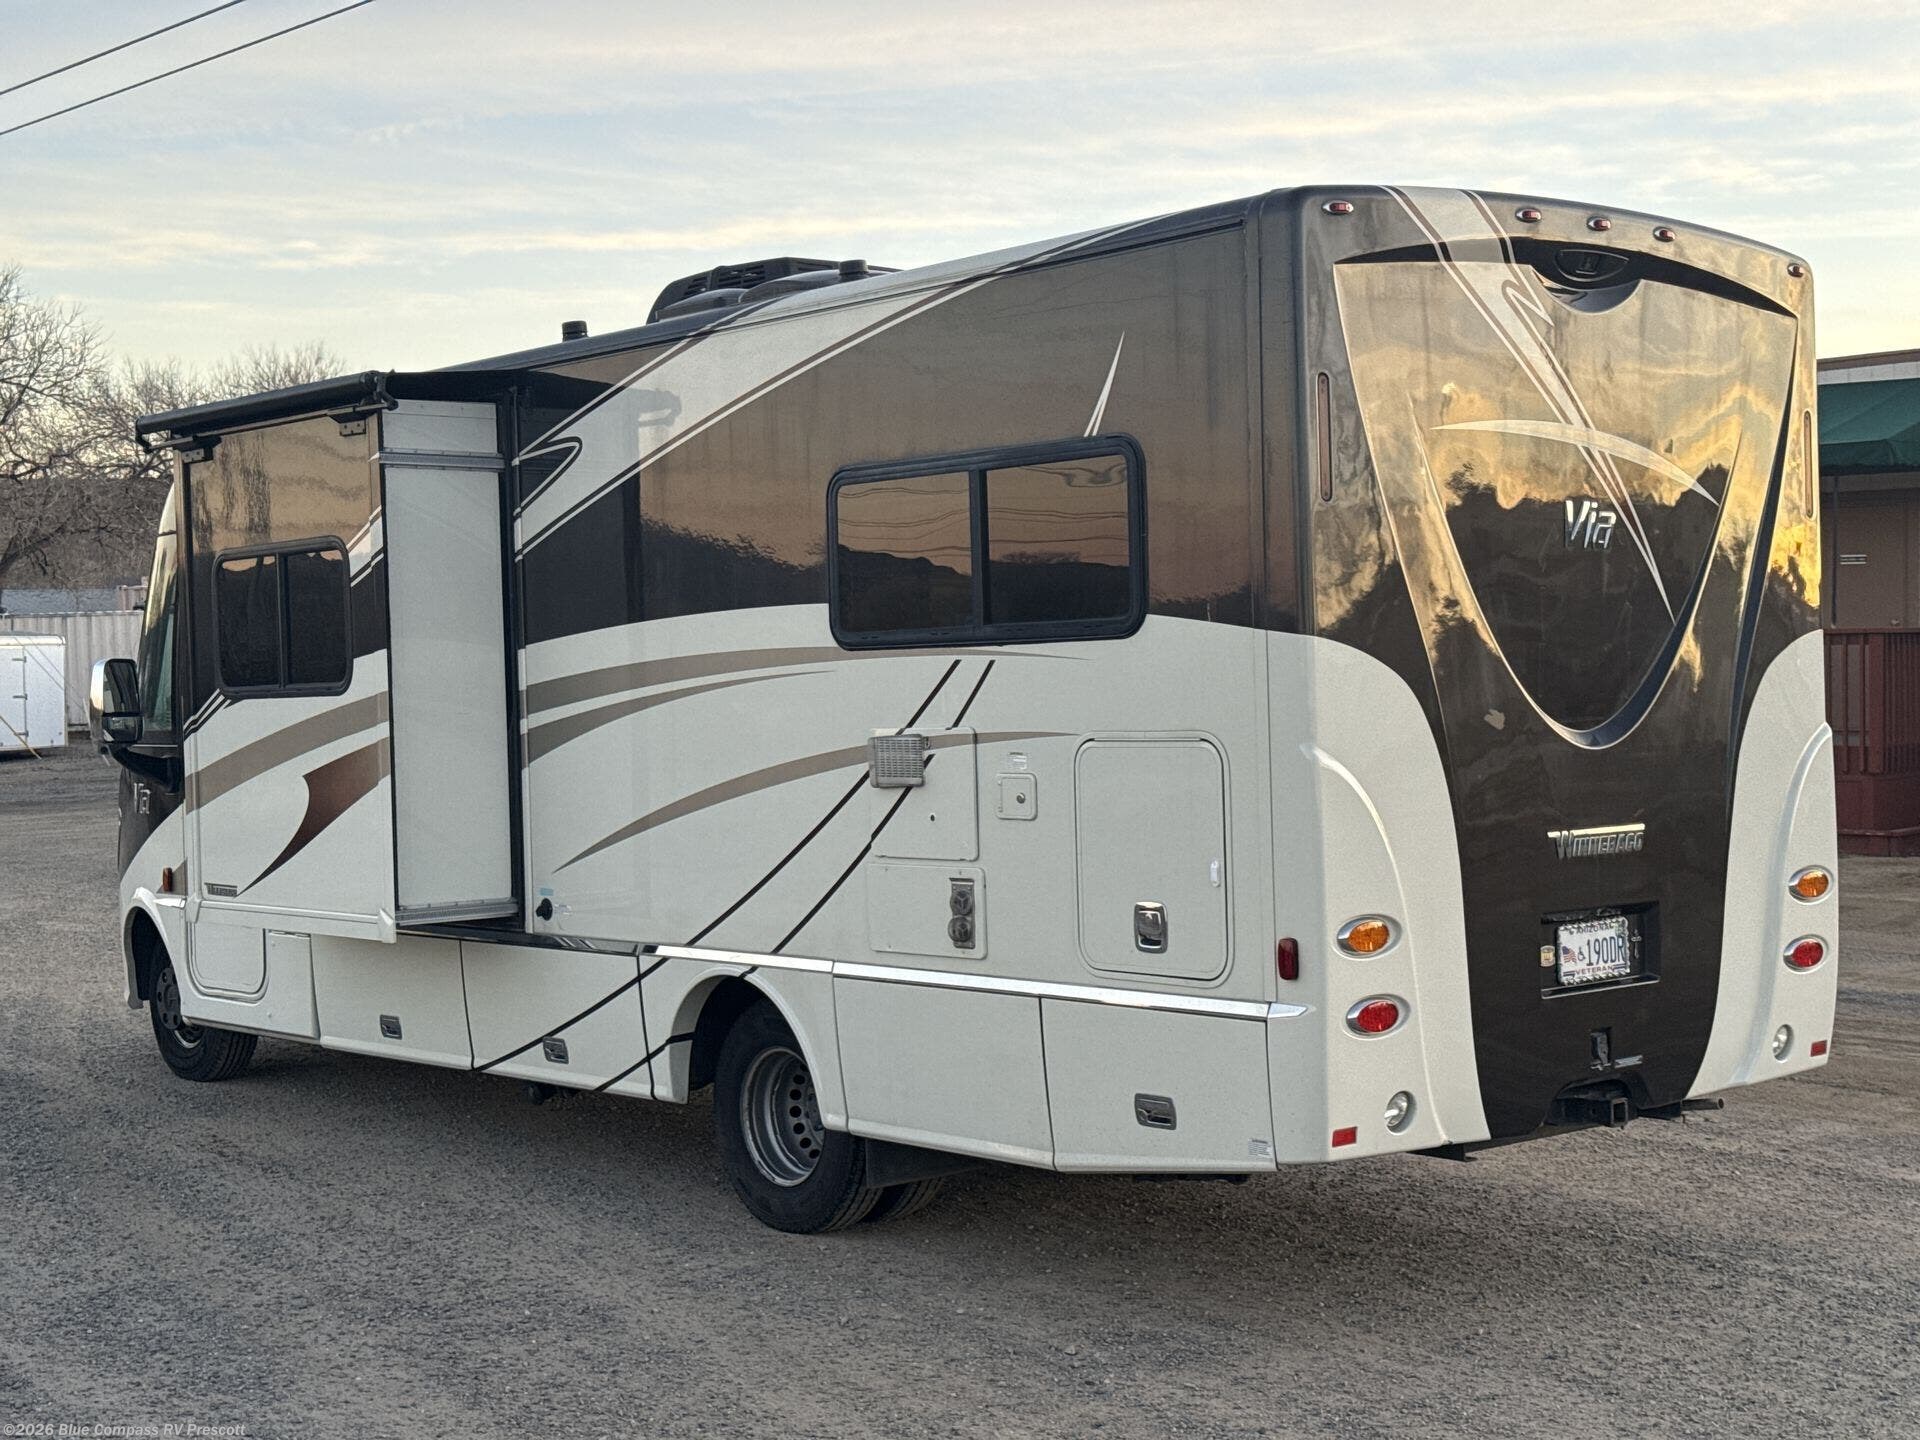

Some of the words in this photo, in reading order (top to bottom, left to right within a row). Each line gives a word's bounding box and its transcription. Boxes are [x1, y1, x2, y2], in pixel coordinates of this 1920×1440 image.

[1565, 500, 1617, 549] Via
[1586, 935, 1626, 966] 190DR
[1575, 965, 1615, 975] VETERAN
